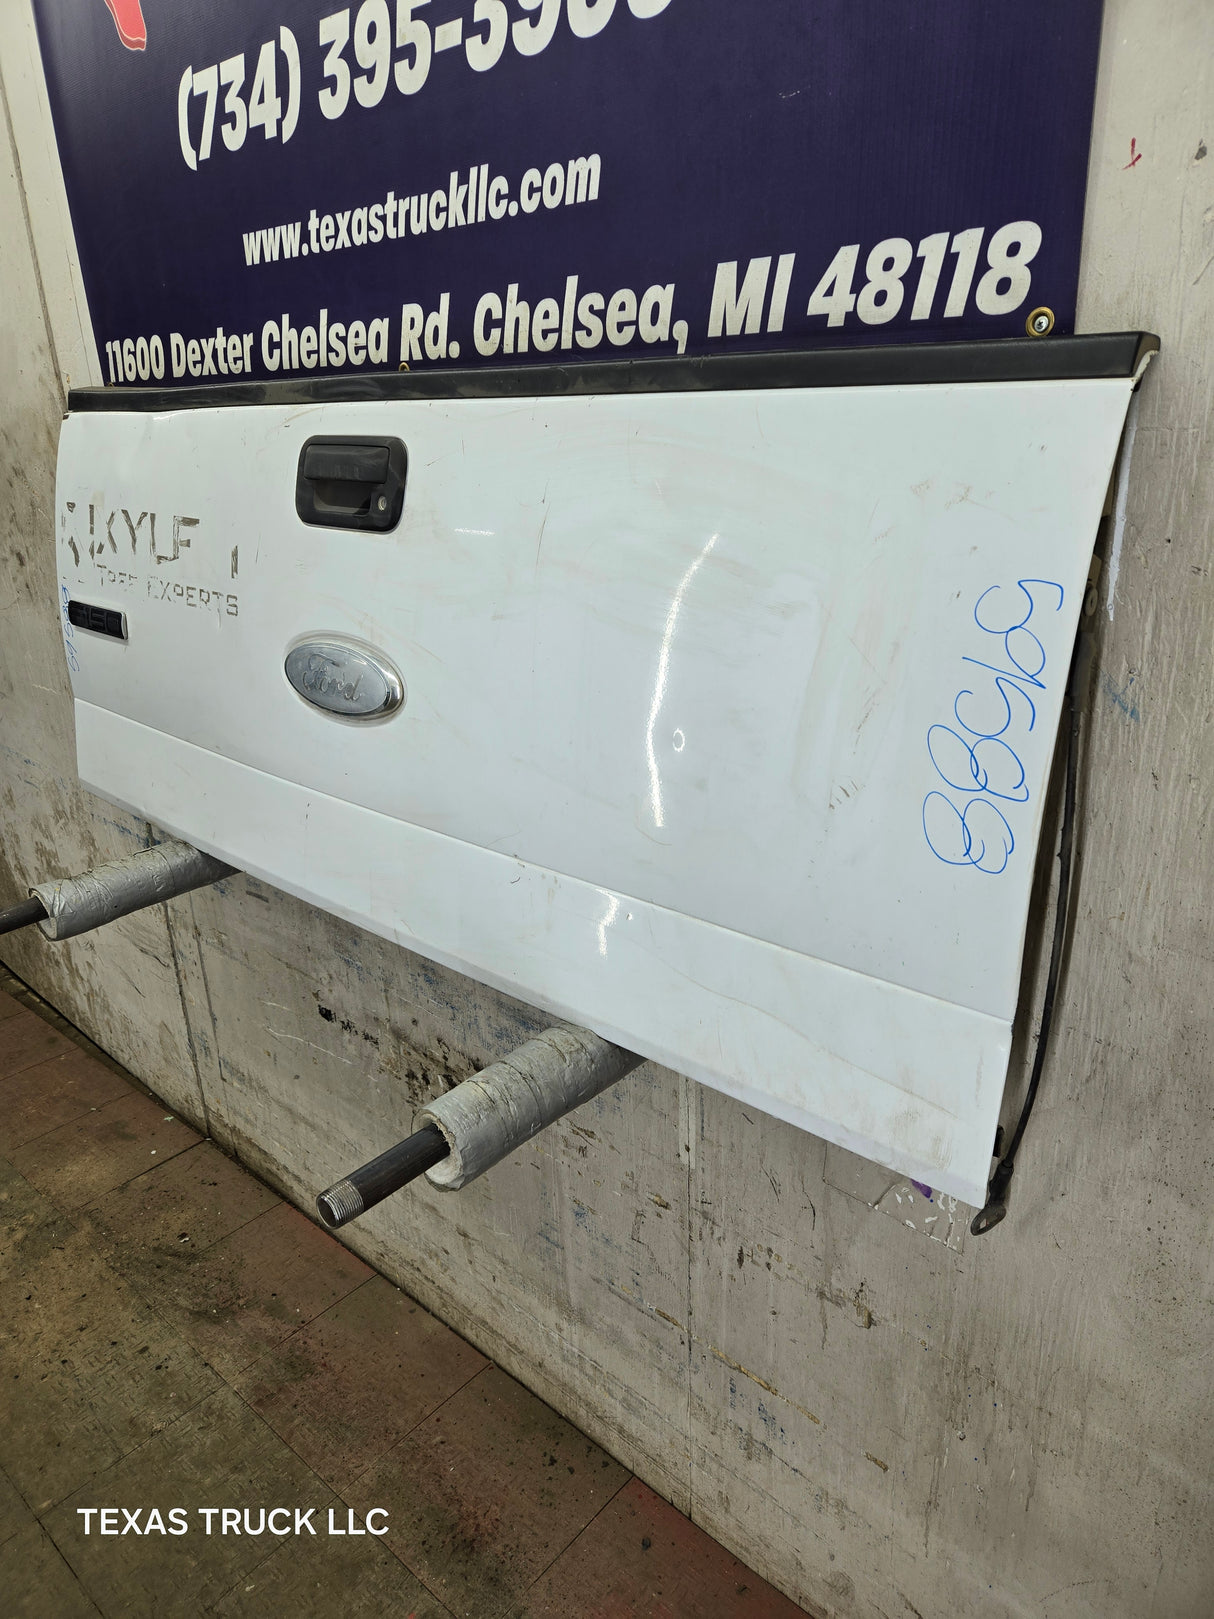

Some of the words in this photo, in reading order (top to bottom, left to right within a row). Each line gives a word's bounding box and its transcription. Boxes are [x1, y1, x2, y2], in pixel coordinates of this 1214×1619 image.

[178, 26, 301, 170] (734)
[318, 0, 672, 120] 395-3
[243, 153, 602, 266] www.texastruckllc.com
[106, 335, 165, 383] 11600
[170, 327, 254, 378] Dexter
[262, 308, 390, 372] Chelsea
[400, 293, 460, 361] Rd.
[474, 275, 688, 355] Chelsea,
[708, 253, 796, 337] MI
[807, 221, 1042, 328] 48118
